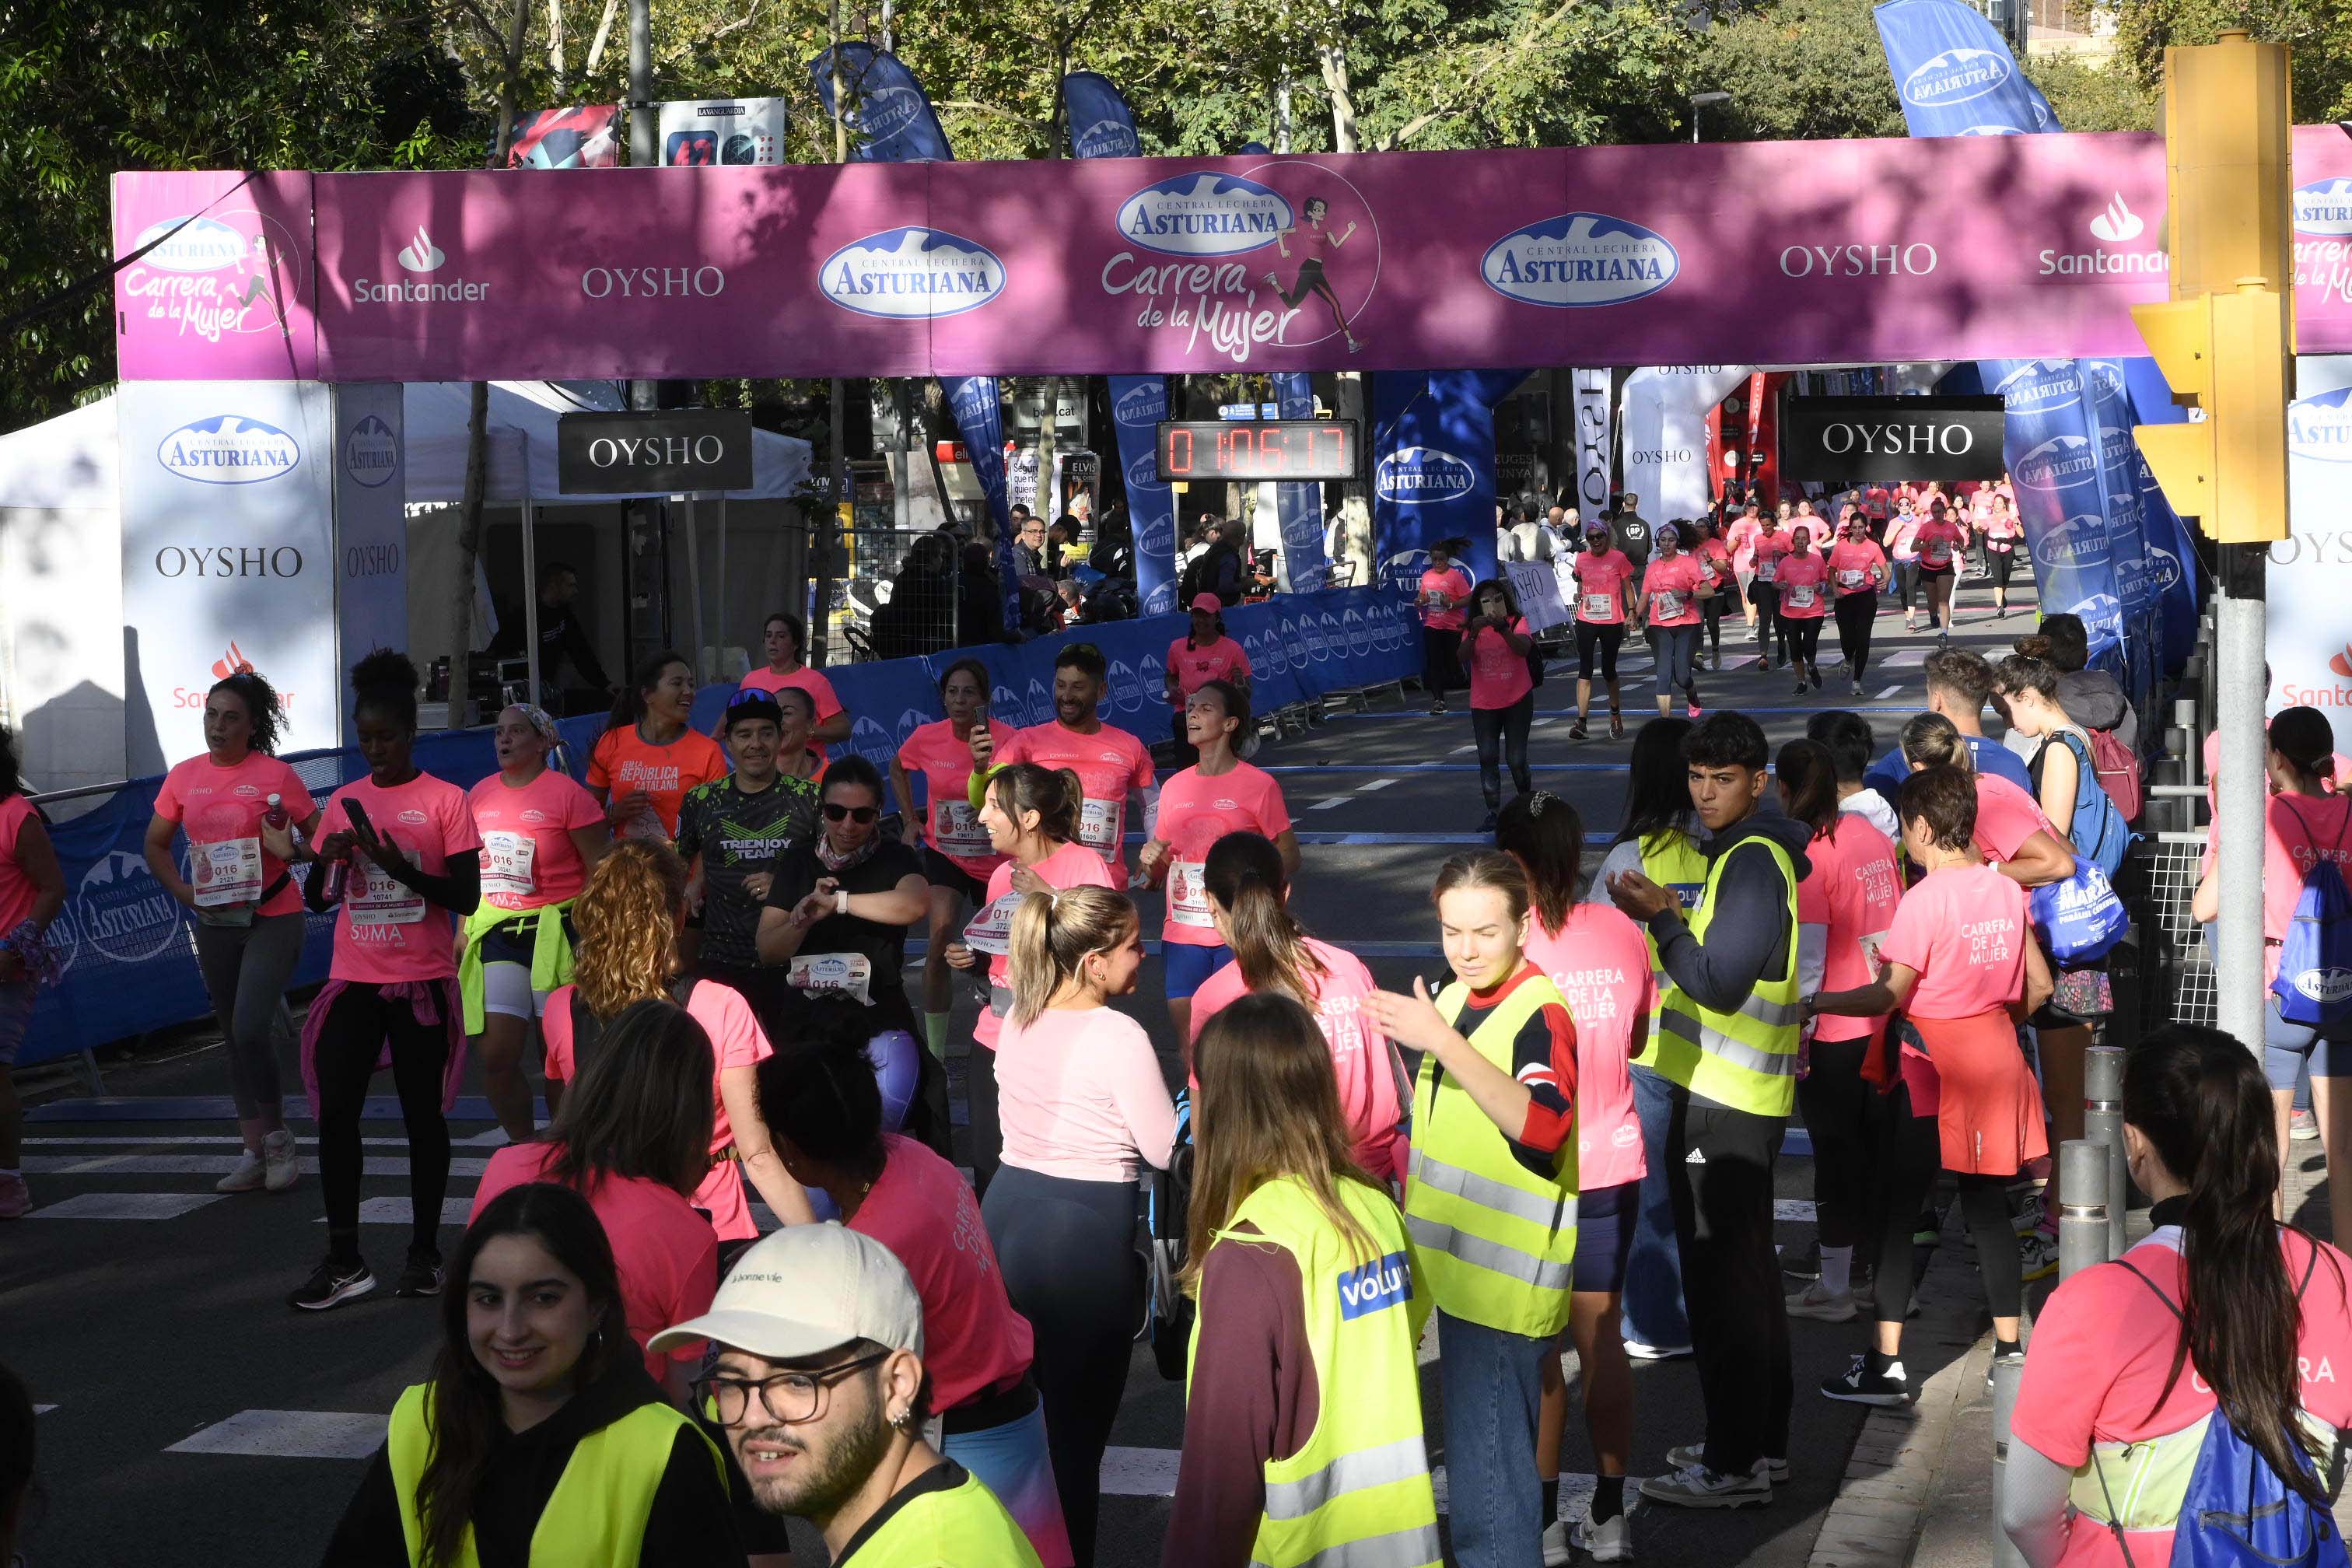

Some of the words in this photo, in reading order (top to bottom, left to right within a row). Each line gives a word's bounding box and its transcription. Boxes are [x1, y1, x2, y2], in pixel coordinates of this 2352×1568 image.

[1157, 201, 1214, 211] CENTRAL
[1219, 199, 1275, 209] LECHERA
[1130, 205, 1279, 235] ASTURIANA
[1527, 246, 1588, 256] CENTRAL
[1594, 243, 1657, 254] LECHERA
[862, 258, 919, 269] CENTRAL
[926, 257, 985, 268] LECHERA
[1496, 250, 1663, 284] ASTURIANA
[1780, 243, 1937, 278] OYSHO
[2039, 249, 2169, 275] Santand
[125, 268, 218, 297] Carrera
[582, 266, 725, 298] OYSHO
[833, 262, 991, 295] ASTURIANA
[1101, 252, 1246, 296] Carrera
[354, 278, 489, 303] Santander
[149, 296, 166, 318] de
[169, 297, 180, 318] la
[179, 296, 252, 342] Mujer
[1137, 297, 1165, 327] de
[1170, 297, 1189, 327] la
[1186, 286, 1303, 362] Mujer
[1822, 423, 1973, 456] OYSHO
[169, 440, 290, 467] ASTURIANA
[350, 446, 394, 469] ASTURIANA
[589, 435, 723, 467] OYSHO
[1633, 449, 1692, 464] OYSHO
[1073, 462, 1096, 472] ELVIS
[1379, 469, 1467, 491] ASTURIANA
[156, 546, 303, 578] OYSHO
[348, 543, 398, 579] OYSHO
[634, 779, 678, 792] CATALANA
[955, 822, 976, 831] 016
[720, 838, 793, 852] TRIENJOY
[734, 849, 776, 859] TEAM
[215, 864, 238, 877] 016
[494, 855, 513, 866] 016
[1855, 858, 1894, 880] CARRERA
[219, 876, 234, 884] 2121
[369, 880, 396, 892] 016
[1866, 877, 1878, 891] DE
[1878, 873, 1890, 886] LA
[1867, 885, 1895, 905] MUJER
[86, 894, 175, 940] ASTURIANA
[351, 923, 404, 942] SUMA
[1961, 919, 2015, 938] CARRERA
[1972, 936, 1988, 950] DE
[1991, 935, 2006, 948] LA
[1969, 948, 2009, 965] MUJER
[812, 979, 839, 989] 016
[1551, 968, 1626, 989] CARRERA
[1568, 989, 1589, 1006] DE
[1594, 986, 1614, 1002] LA
[1342, 1264, 1410, 1306] VOLU
